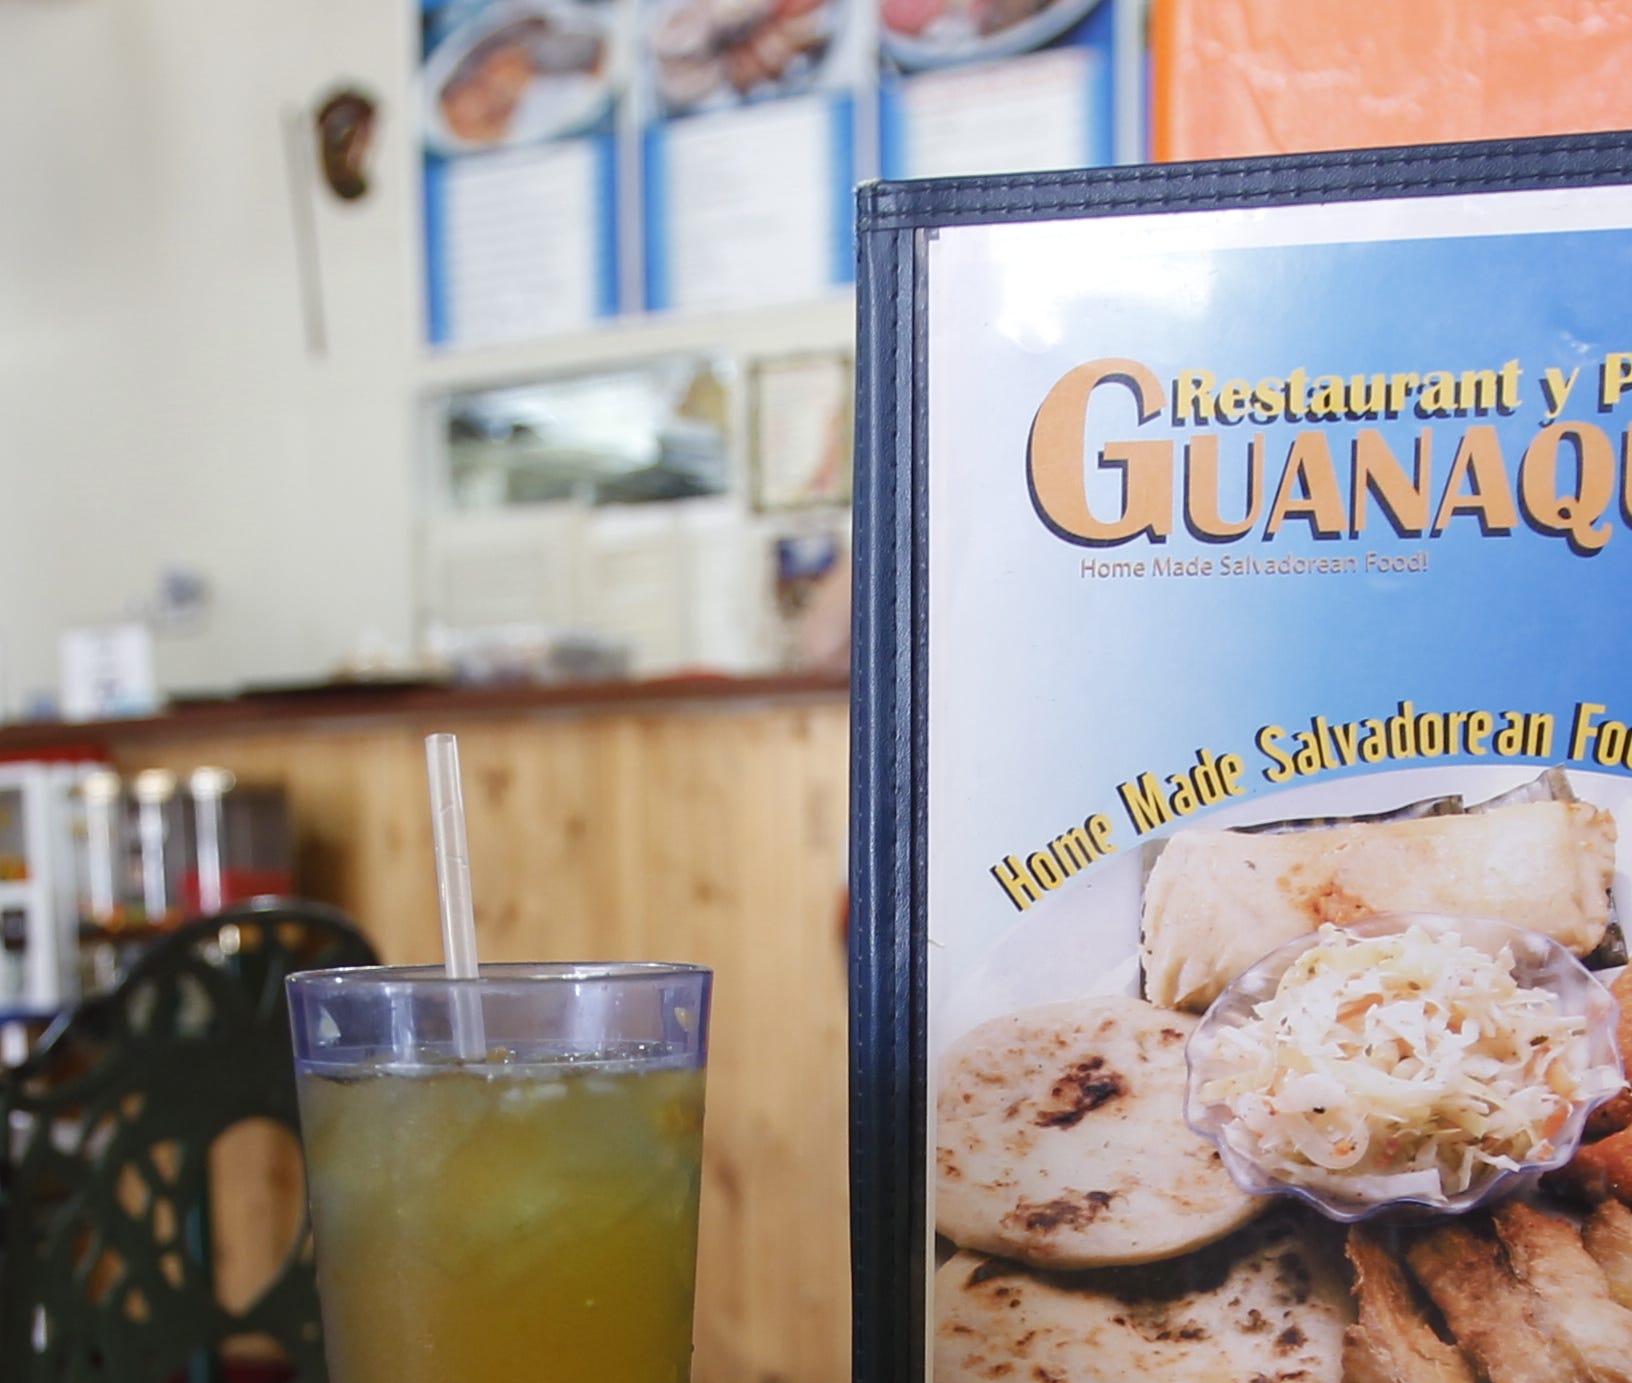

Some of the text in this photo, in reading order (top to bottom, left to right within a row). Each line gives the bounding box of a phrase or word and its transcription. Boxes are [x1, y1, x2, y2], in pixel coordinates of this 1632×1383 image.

[1172, 358, 1523, 426] Restaurant
[1539, 367, 1580, 426] y
[1080, 550, 1431, 579] Home Made Salvadorean Food!
[989, 813, 1120, 912] Home
[1116, 747, 1246, 836] Made
[1255, 700, 1555, 784] Salvadorean
